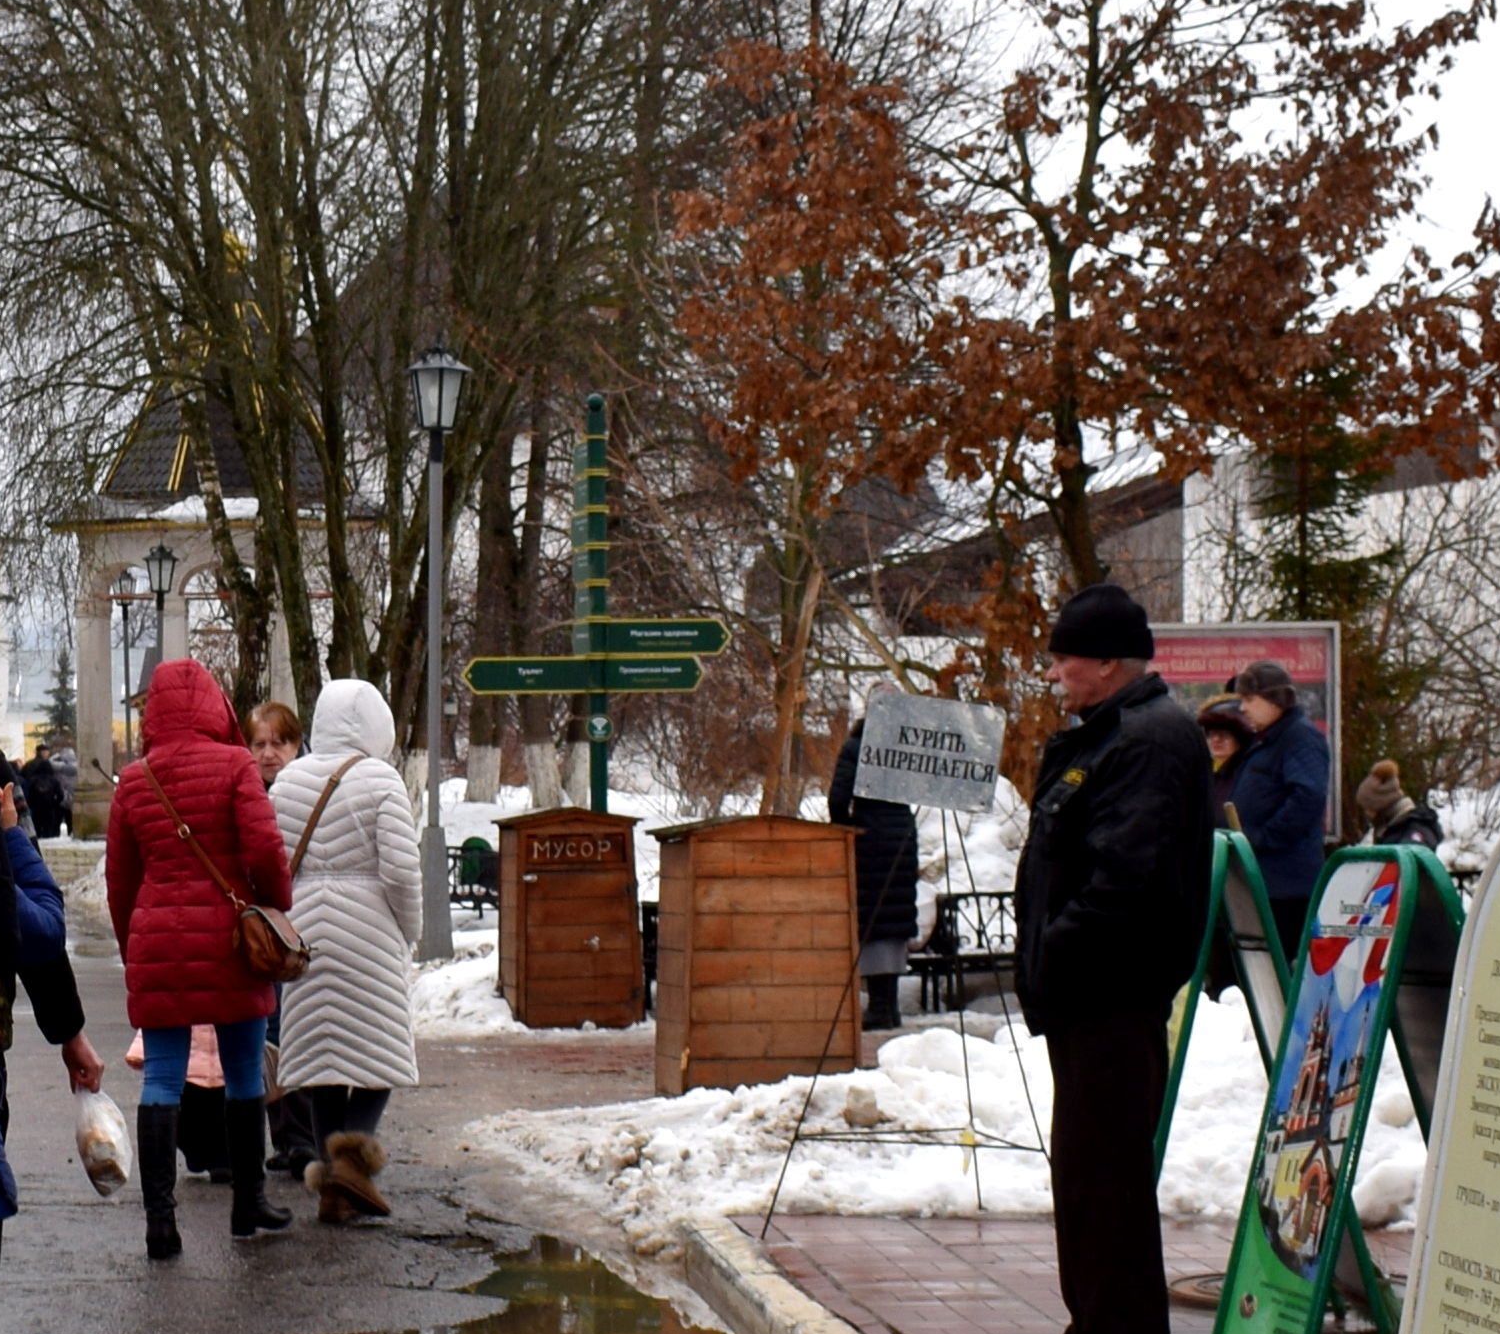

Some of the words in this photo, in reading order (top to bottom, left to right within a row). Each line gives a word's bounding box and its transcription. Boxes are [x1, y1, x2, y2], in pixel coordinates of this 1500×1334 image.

[898, 725, 966, 755] КУРИТЬ
[861, 746, 996, 784] ЗАПРЕЩАЕТСЯ
[532, 839, 612, 861] МУСОР
[1438, 1250, 1482, 1279] СТОИМОСТЬ
